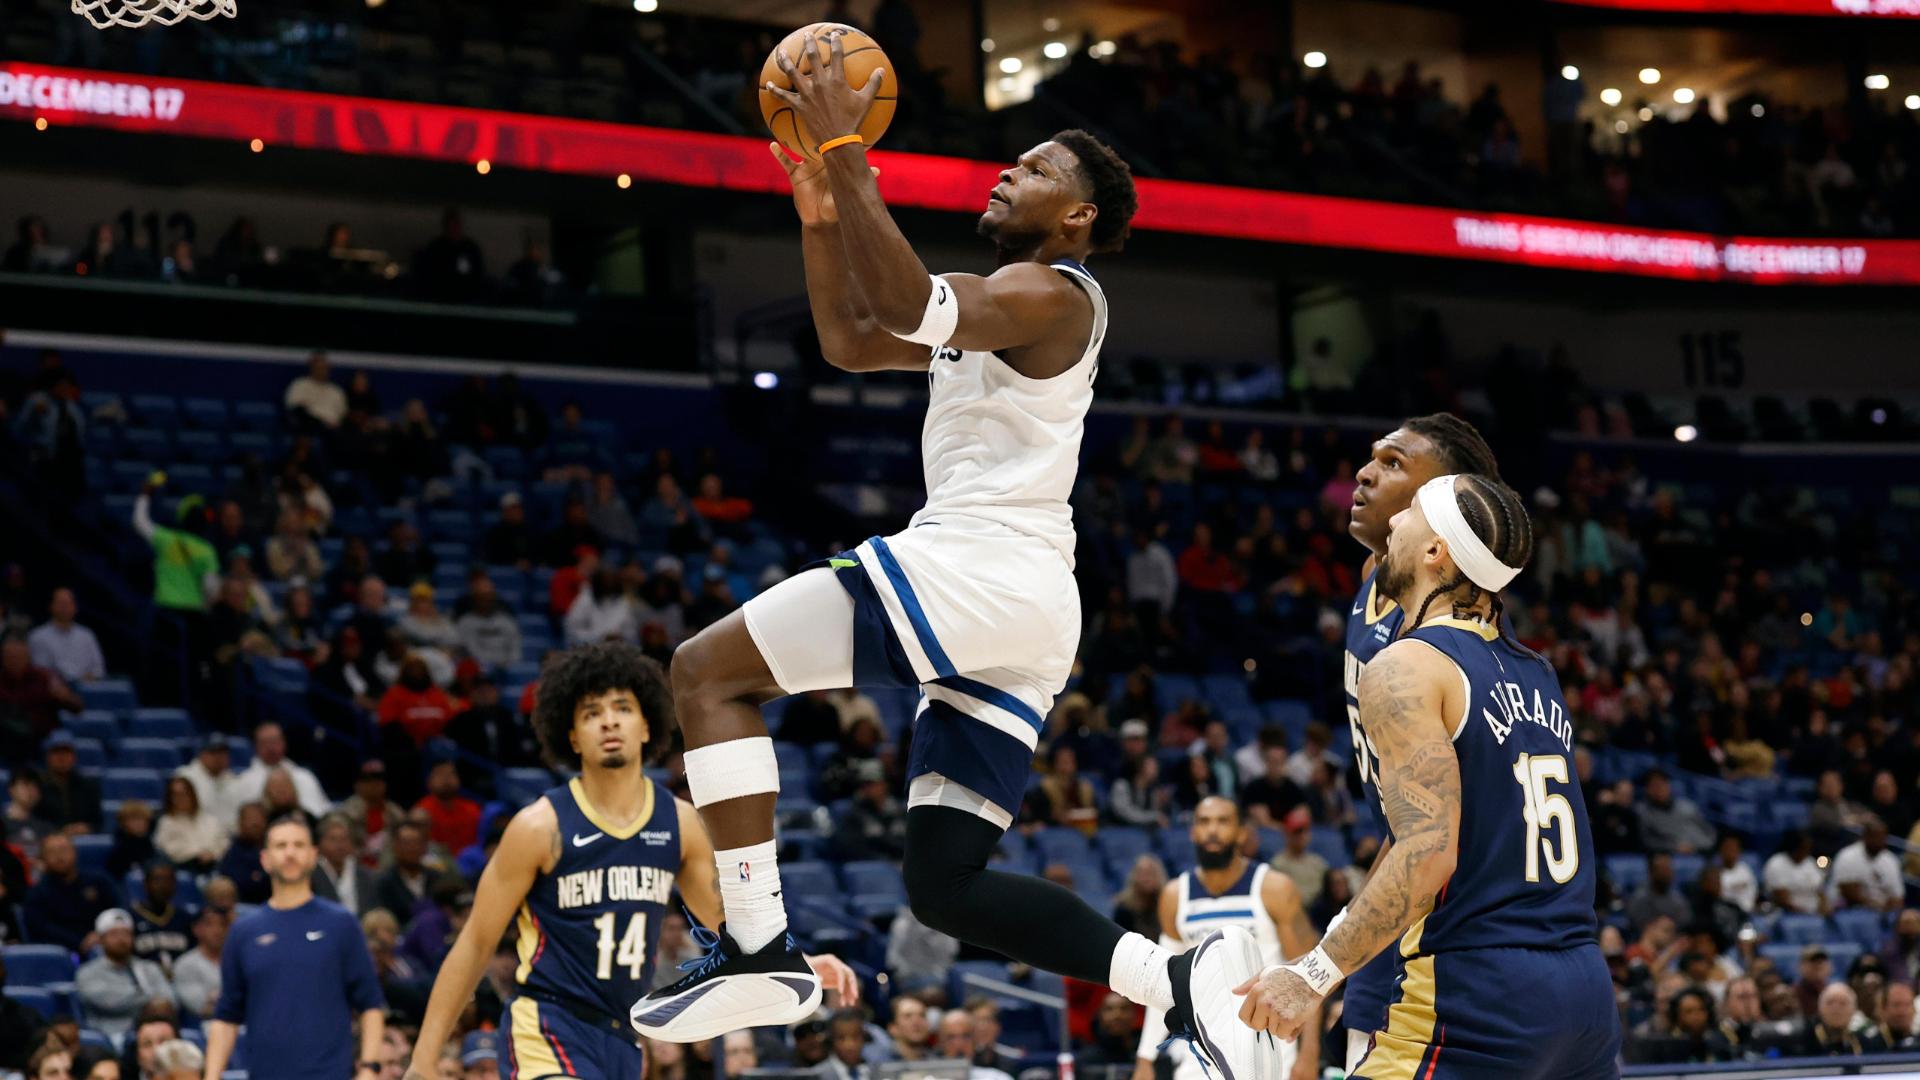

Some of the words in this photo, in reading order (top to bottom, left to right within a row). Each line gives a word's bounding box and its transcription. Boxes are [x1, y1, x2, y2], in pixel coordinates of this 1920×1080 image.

[153, 87, 185, 121] 17
[1679, 330, 1744, 389] 115
[1512, 751, 1580, 885] 15
[557, 868, 604, 910] NEW
[607, 865, 675, 906] ORLEAN
[594, 911, 648, 981] 14
